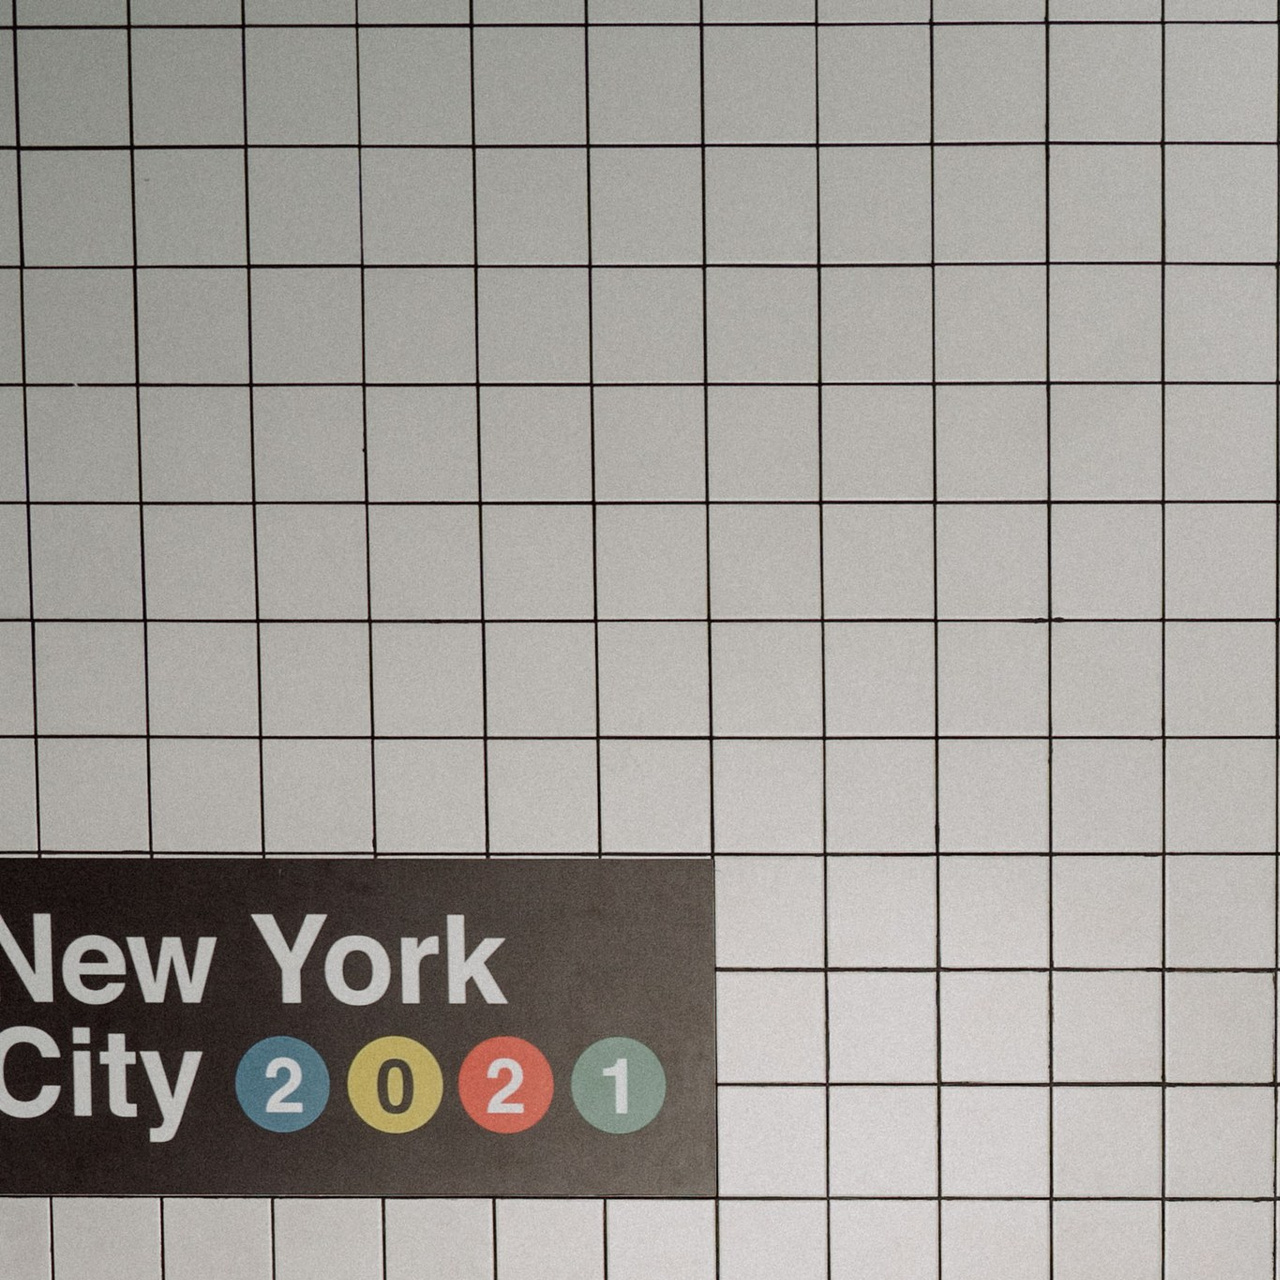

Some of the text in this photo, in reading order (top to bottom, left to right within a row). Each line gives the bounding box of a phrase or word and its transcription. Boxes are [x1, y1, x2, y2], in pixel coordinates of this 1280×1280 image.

[0, 913, 509, 1007] New York
[0, 1025, 630, 1143] City 2 0 2 1
